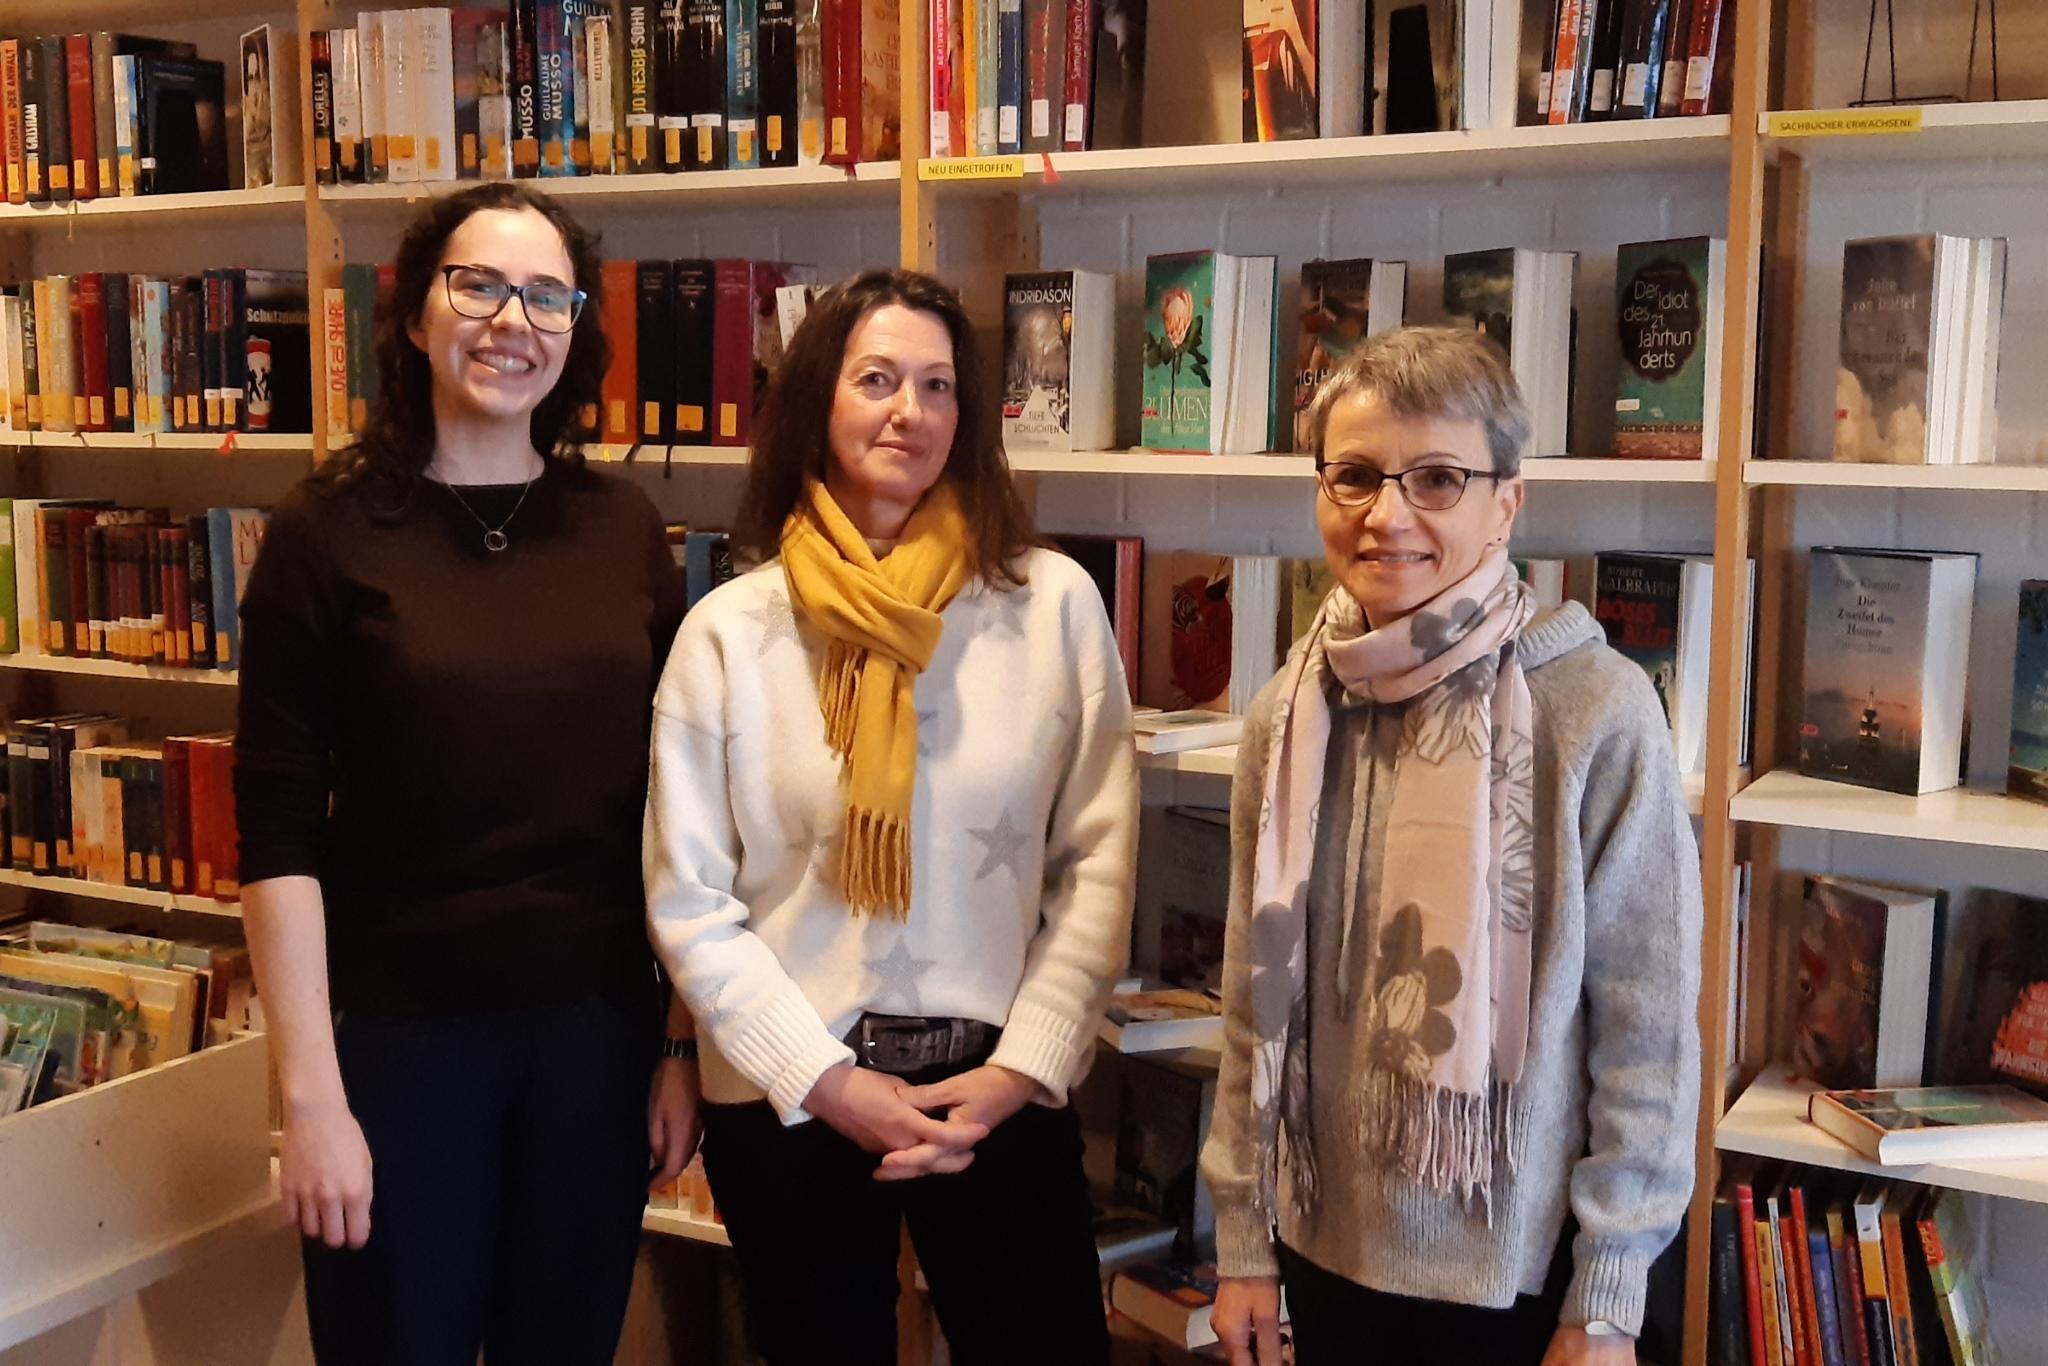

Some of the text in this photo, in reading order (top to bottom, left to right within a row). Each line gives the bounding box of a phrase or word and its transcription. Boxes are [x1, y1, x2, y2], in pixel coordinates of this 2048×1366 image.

[1072, 15, 1083, 41] Koch
[5, 48, 17, 87] ANWALT
[630, 6, 647, 113] JO NESBØ SOHN
[1070, 42, 1081, 80] Samuel
[6, 90, 18, 110] DER
[542, 54, 551, 121] GUILLAUME
[551, 54, 562, 121] MUSSO
[521, 84, 534, 139] MUSSO
[25, 104, 38, 149] GRISHAM
[928, 163, 1013, 175] NEU EINGETROFFEN
[1634, 280, 1660, 301] Der
[1623, 305, 1650, 322] des
[1637, 328, 1692, 349] Jahrhun
[1640, 349, 1676, 369] derts
[1858, 595, 1877, 607] Die
